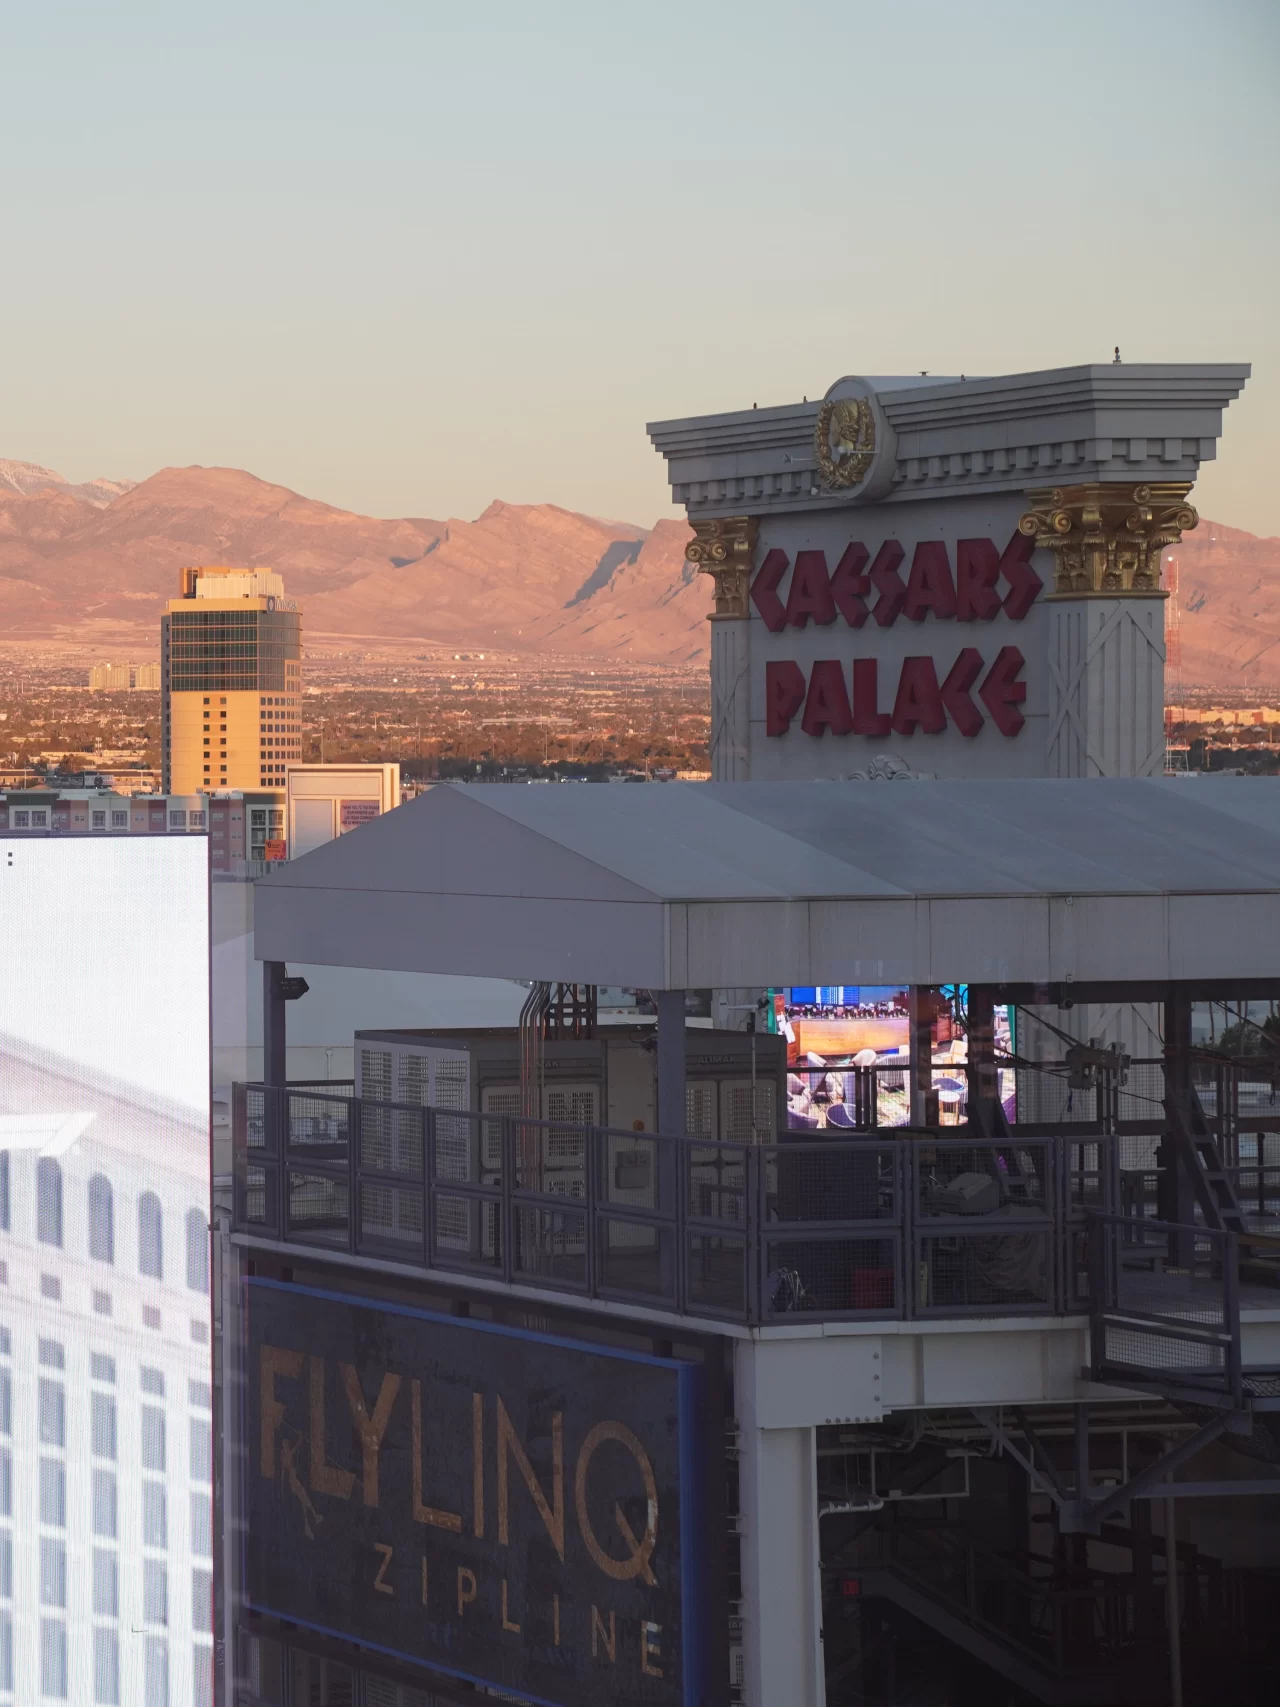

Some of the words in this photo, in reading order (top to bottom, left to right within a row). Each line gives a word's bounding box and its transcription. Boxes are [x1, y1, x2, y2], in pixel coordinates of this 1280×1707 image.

[750, 529, 1043, 632] CAESARS
[766, 646, 1026, 737] PALACE
[373, 1542, 664, 1678] ZIPLINE
